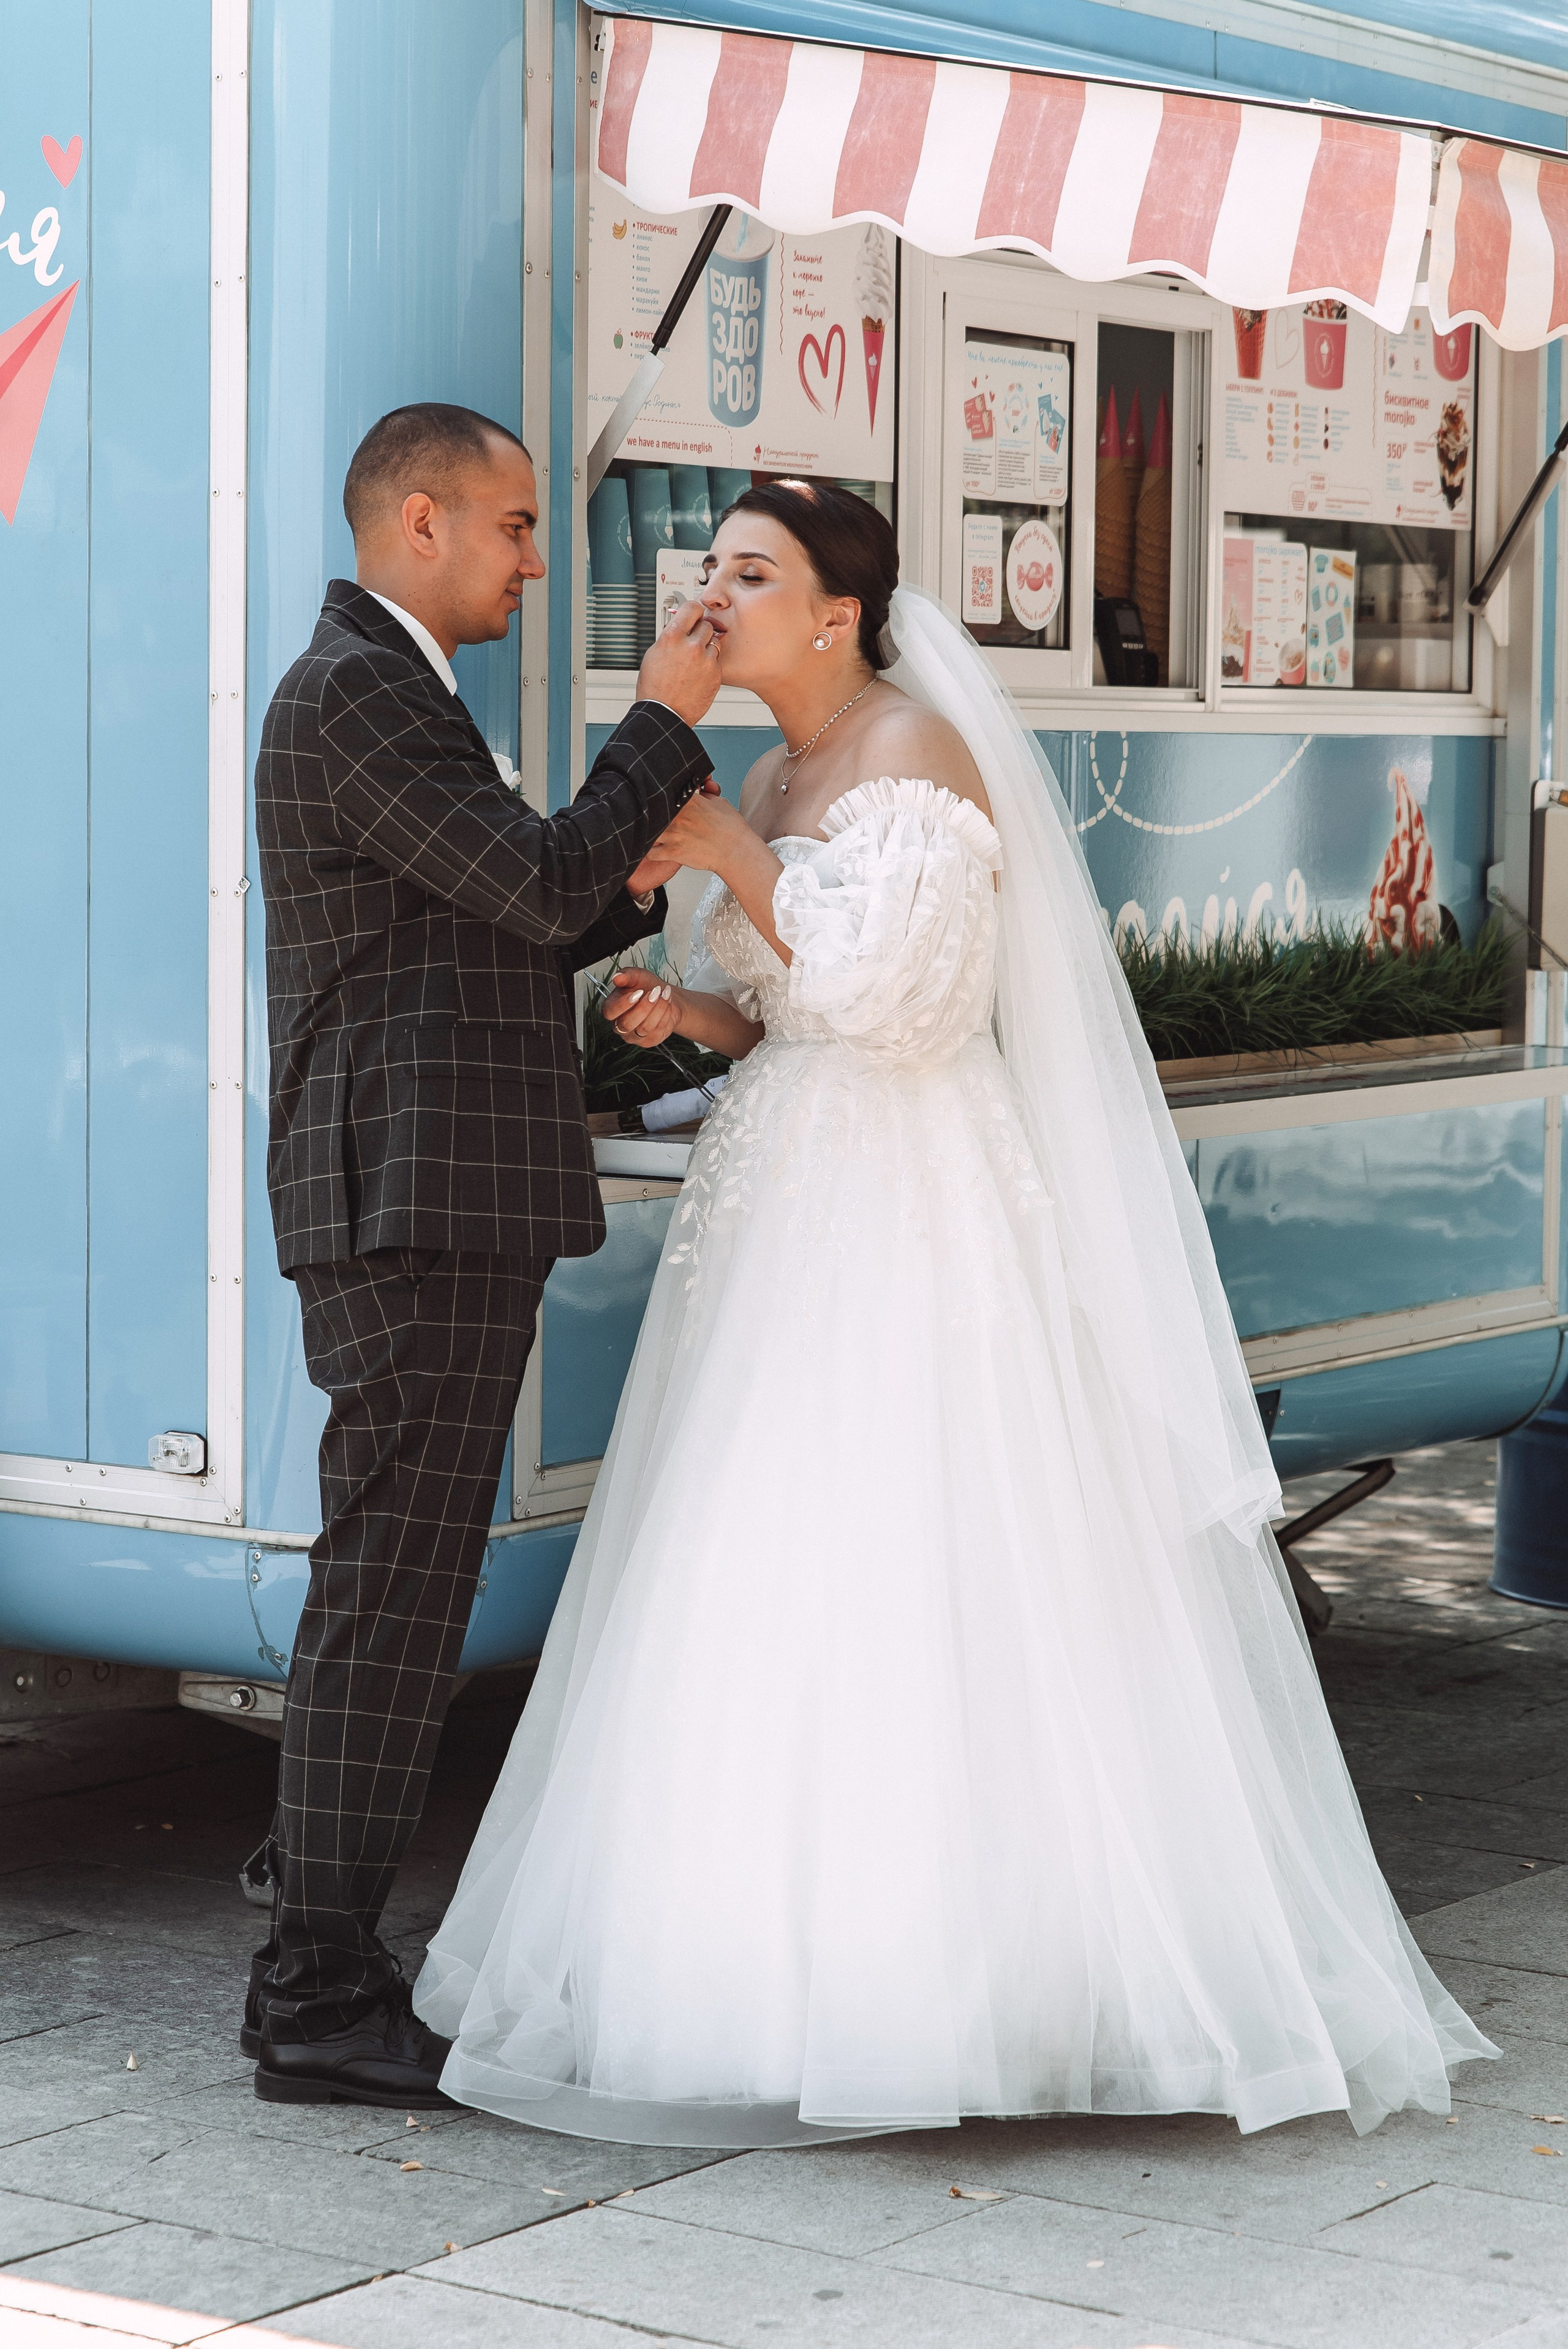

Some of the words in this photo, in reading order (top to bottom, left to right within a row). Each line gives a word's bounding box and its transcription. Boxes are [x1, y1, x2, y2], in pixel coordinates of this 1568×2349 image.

[636, 222, 678, 236] ТРОПИЧЕСКИЕ
[636, 254, 650, 262] банан
[793, 250, 823, 264] Закажите
[636, 287, 660, 295] мандарин
[710, 268, 761, 317] БУДЬ
[793, 289, 805, 300] кофе
[793, 306, 802, 315] это
[804, 303, 826, 322] вкусно!
[712, 311, 758, 364] ЗДО
[713, 358, 756, 412] РОВ
[1384, 390, 1429, 410] бисквитное
[1384, 410, 1415, 428] morojko
[627, 437, 636, 447] we
[639, 436, 654, 448] have
[662, 441, 680, 450] menu
[682, 440, 688, 451] in
[690, 442, 712, 454] english
[968, 522, 982, 531] Будьте
[975, 533, 994, 541] telegram
